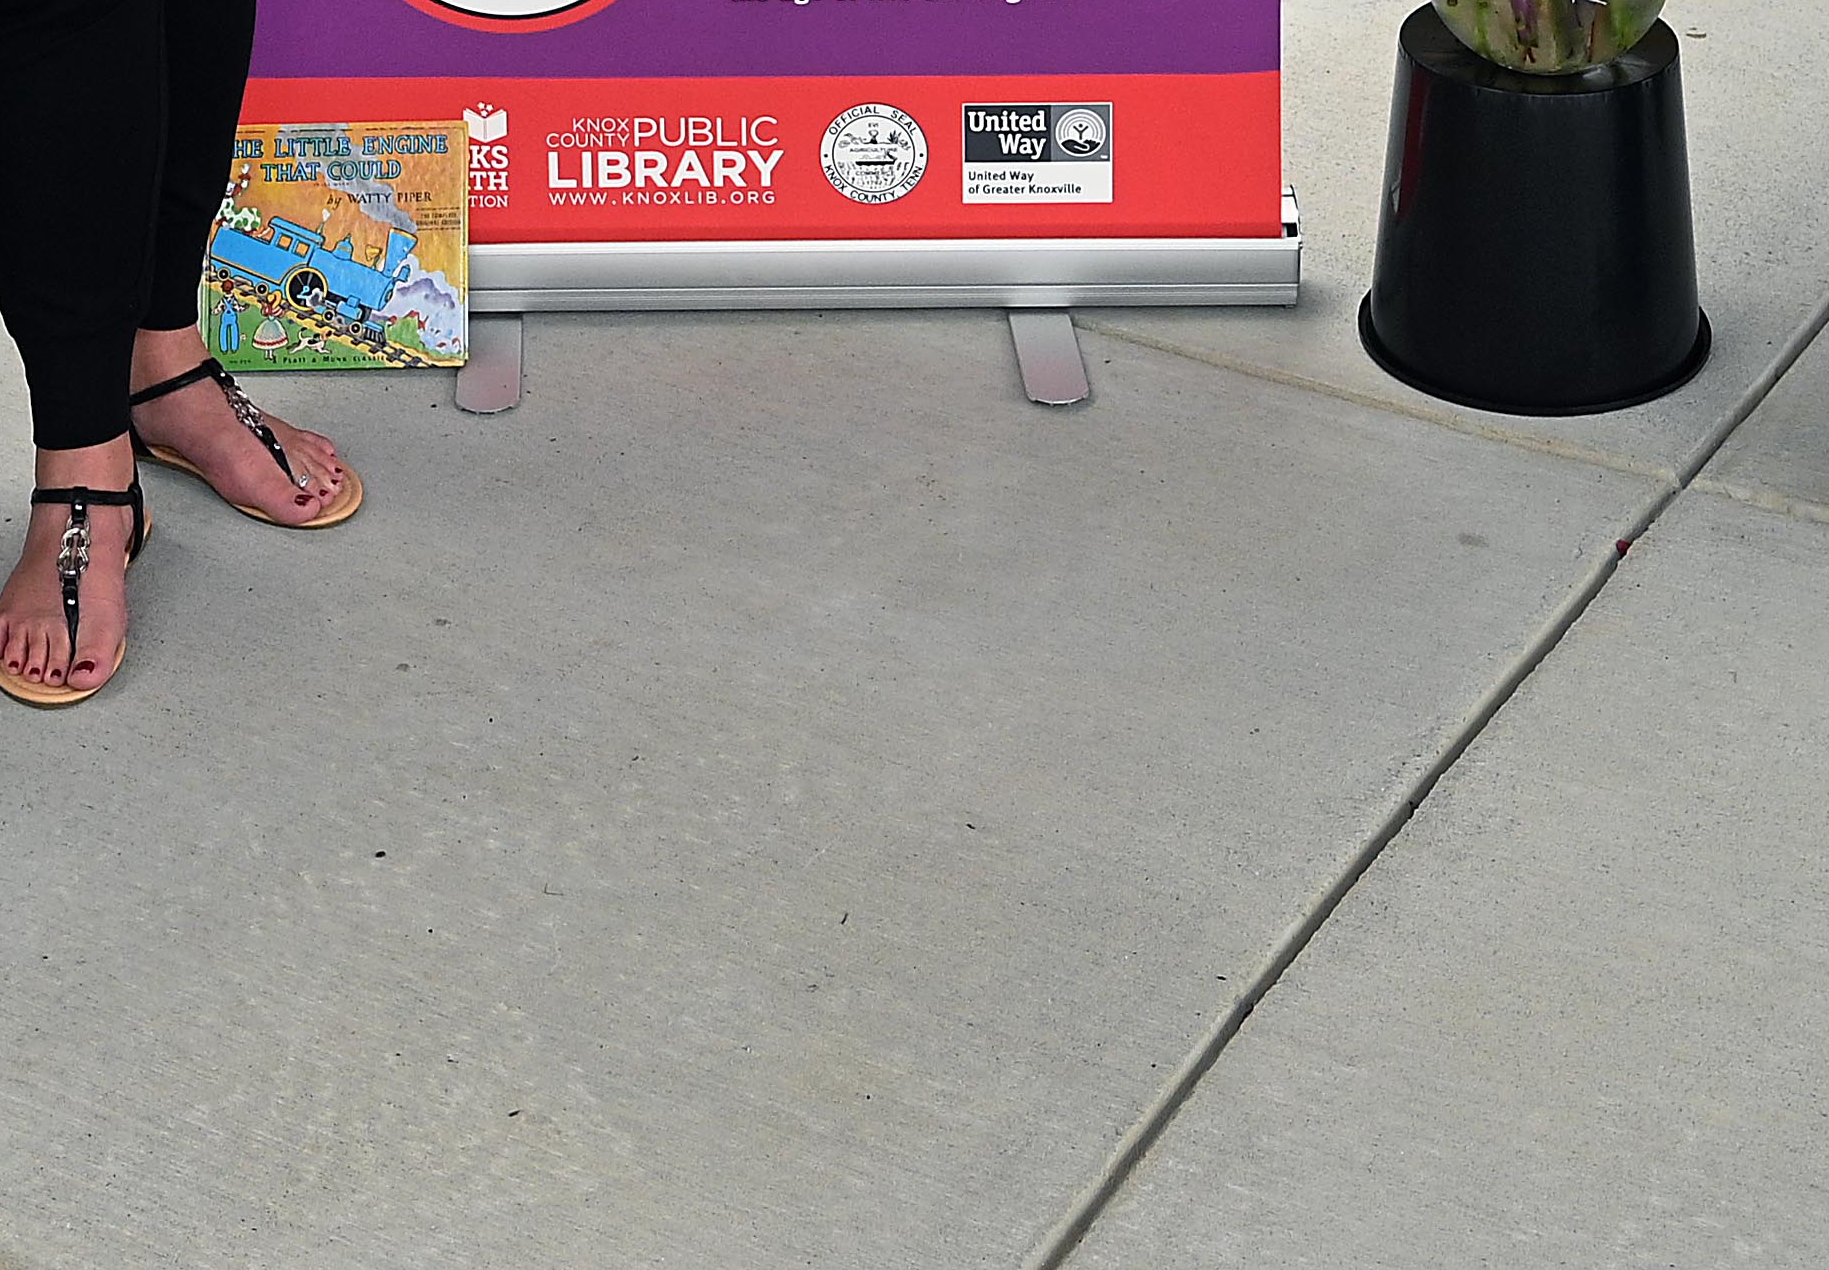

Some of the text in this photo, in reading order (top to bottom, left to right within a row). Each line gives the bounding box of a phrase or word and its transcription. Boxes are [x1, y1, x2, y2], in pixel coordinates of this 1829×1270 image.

[573, 118, 630, 132] KNOX
[633, 116, 778, 147] PUBLIC
[829, 106, 918, 135] OFFICIAL SEAL
[968, 110, 1047, 132] United
[233, 134, 448, 158] HE LITTLE ENGINE
[546, 133, 630, 148] COUNTY
[998, 133, 1047, 160] Way
[261, 159, 402, 182] THAT COULD
[548, 150, 784, 188] LIBRARY
[824, 164, 848, 192] KNOX
[968, 171, 1034, 183] United Way
[549, 191, 776, 205] WWW.KNOXLIB.ORG
[968, 184, 1081, 194] of Greater Knoxville
[327, 192, 432, 209] by WATTY PIPER
